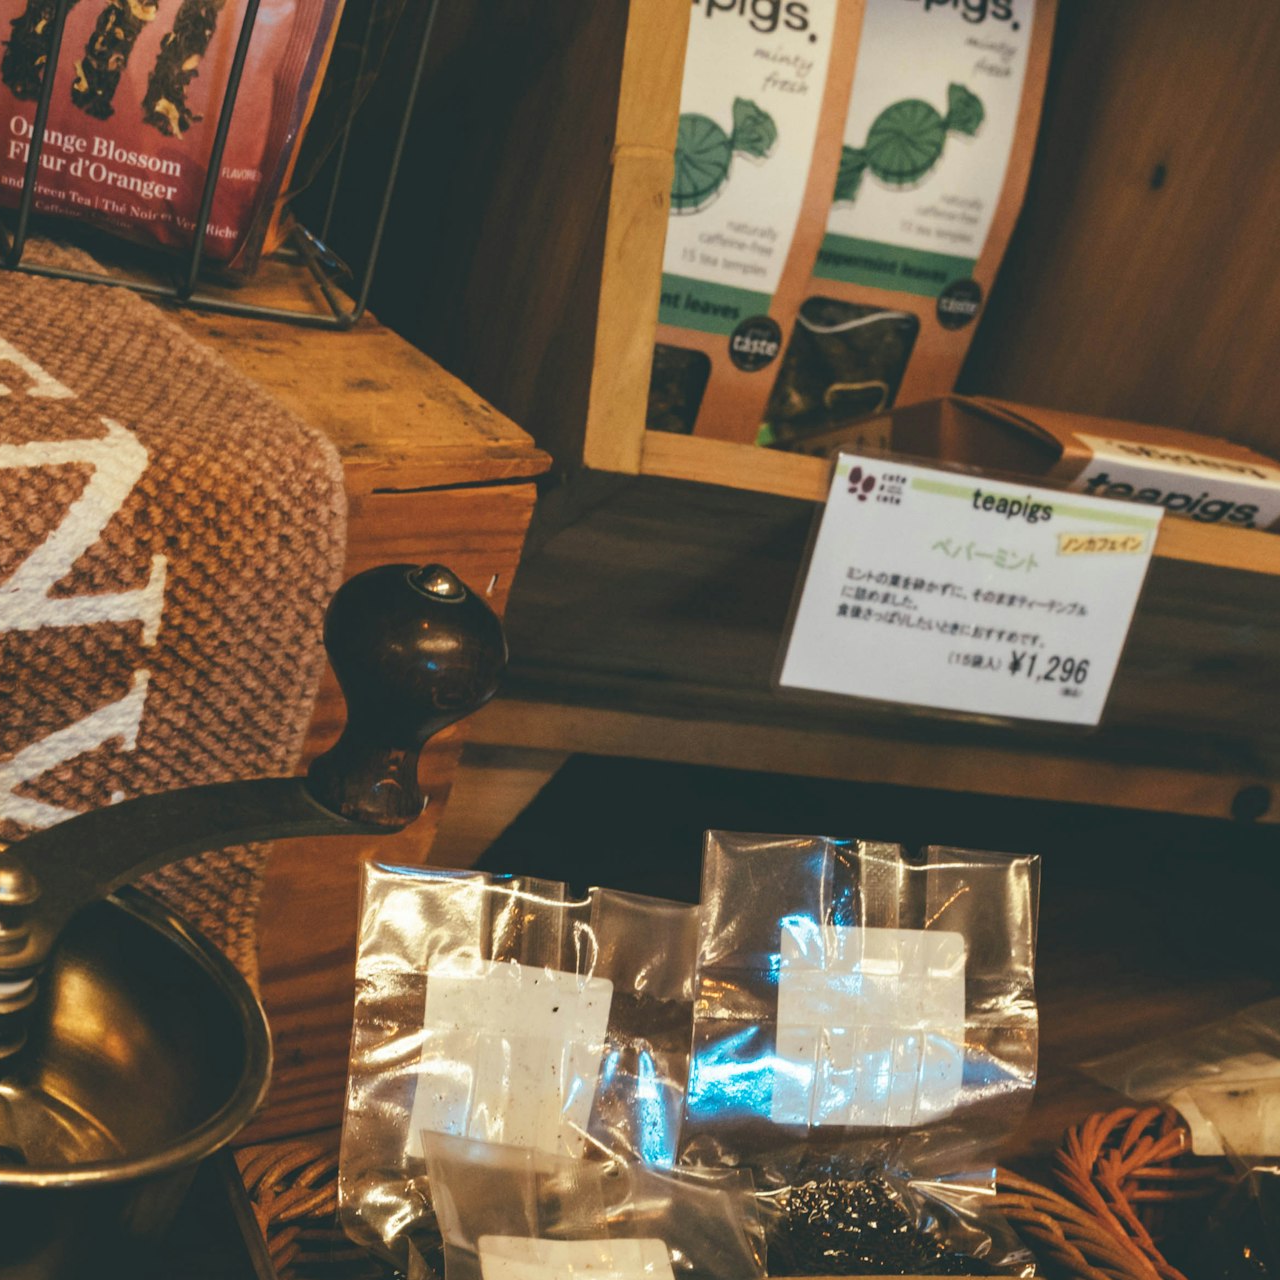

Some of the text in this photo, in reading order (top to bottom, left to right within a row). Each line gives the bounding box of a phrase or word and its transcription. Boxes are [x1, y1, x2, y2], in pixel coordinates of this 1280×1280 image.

[91, 135, 183, 178] Blossom
[1, 172, 25, 189] and
[69, 190, 93, 208] Tea
[101, 196, 128, 215] Thé
[129, 203, 159, 222] Noir
[205, 223, 239, 241] Riche
[687, 300, 740, 320] leaves
[732, 335, 779, 357] taste
[972, 488, 1054, 523] teapigs
[931, 536, 1040, 573] ペパーミント
[1060, 533, 1143, 552] ノンカフェイン
[1008, 650, 1092, 685] ¥1,296
